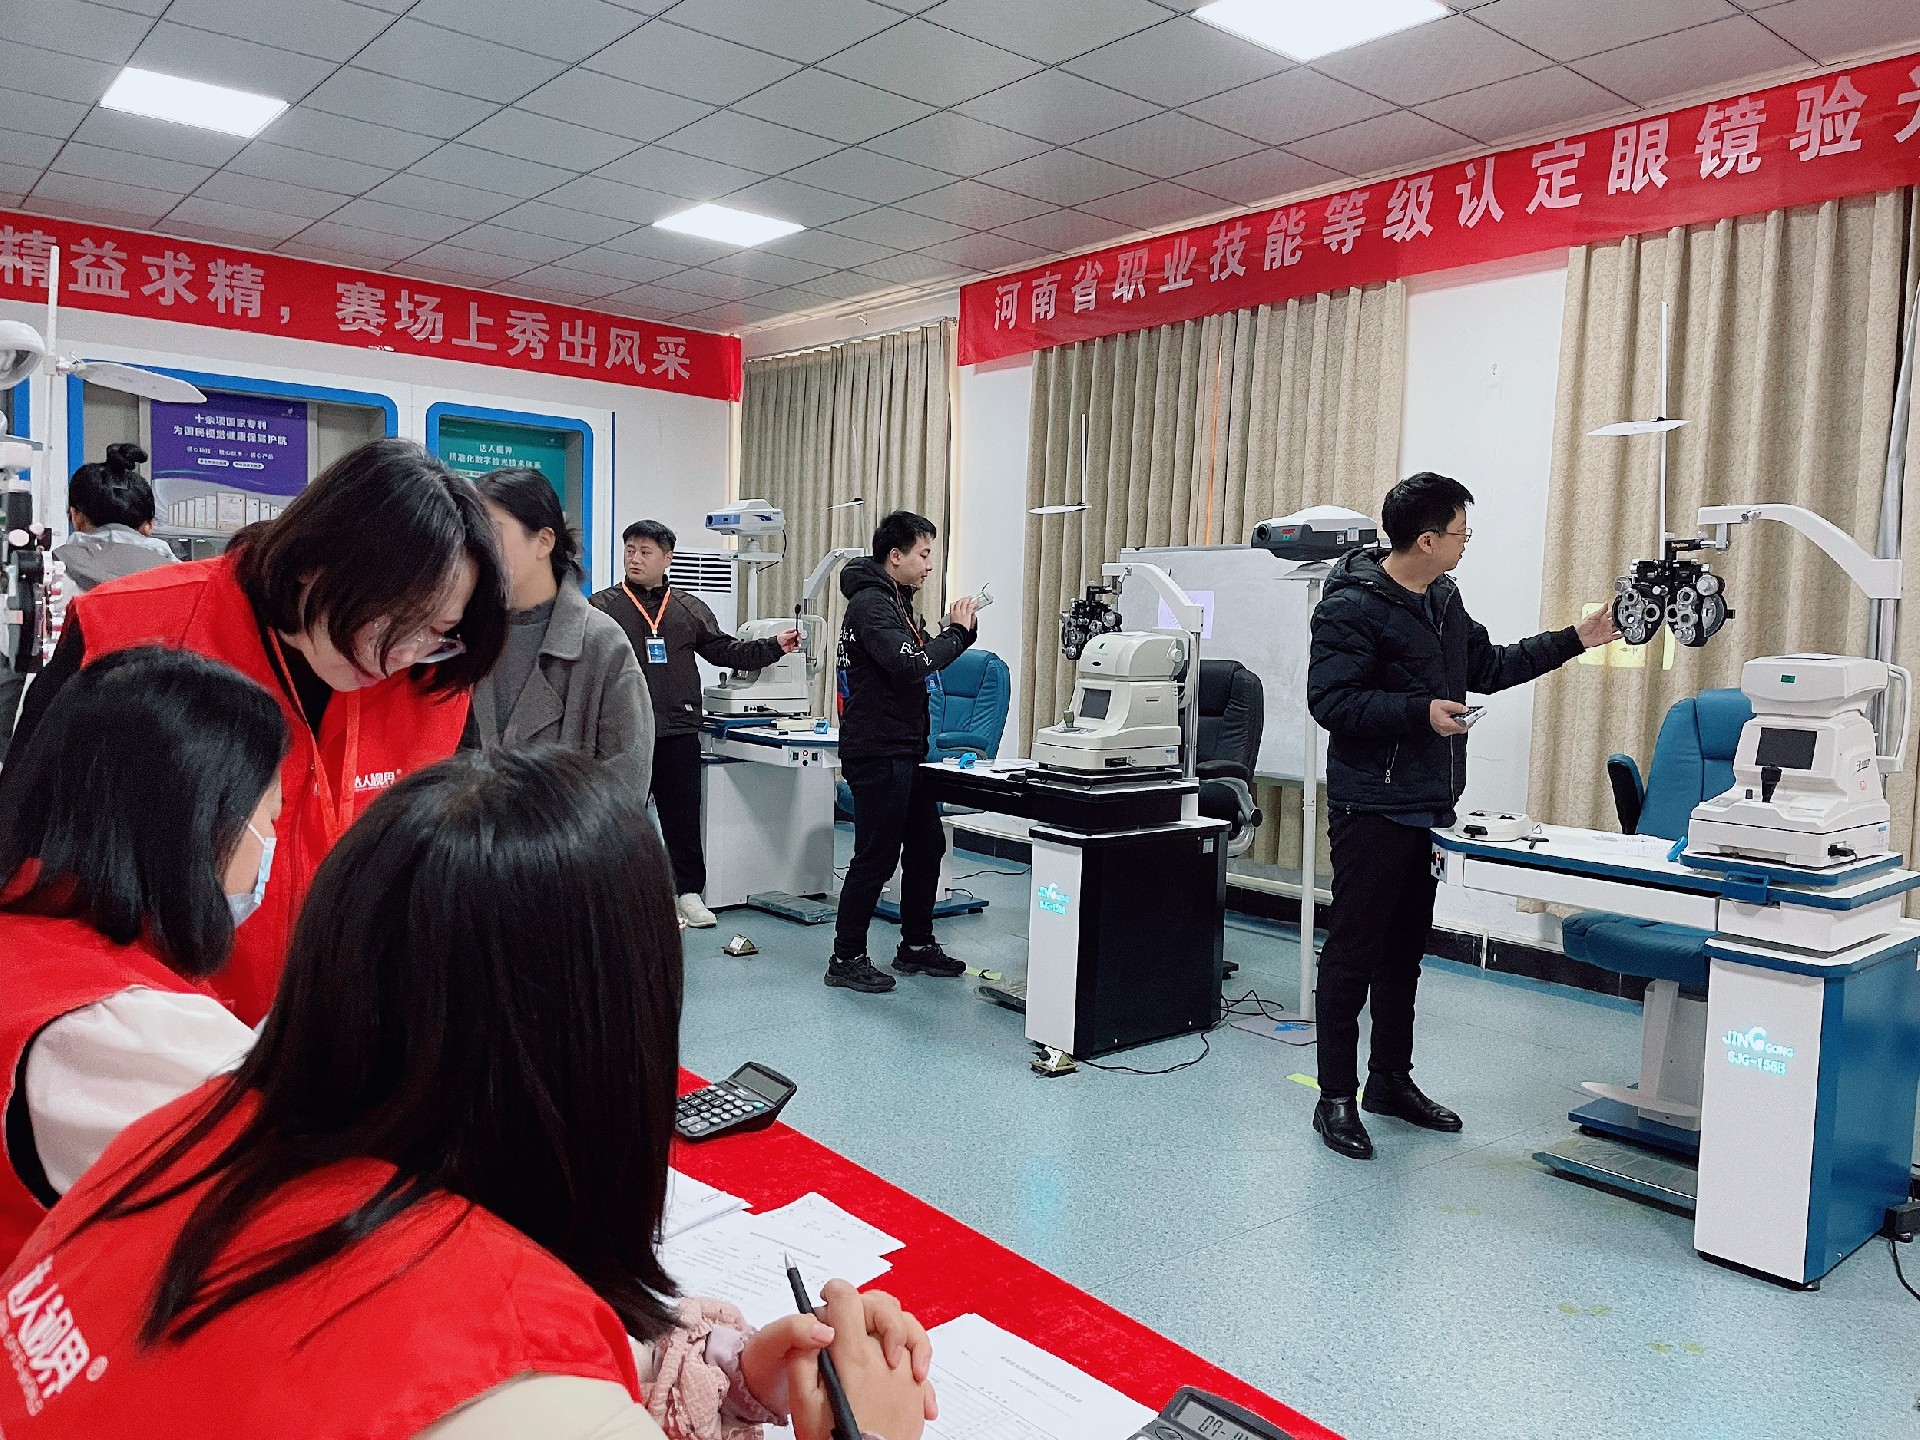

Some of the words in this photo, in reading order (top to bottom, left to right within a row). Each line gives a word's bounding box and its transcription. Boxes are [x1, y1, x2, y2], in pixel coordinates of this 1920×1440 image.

[194, 413, 267, 430] 十余项国家专利
